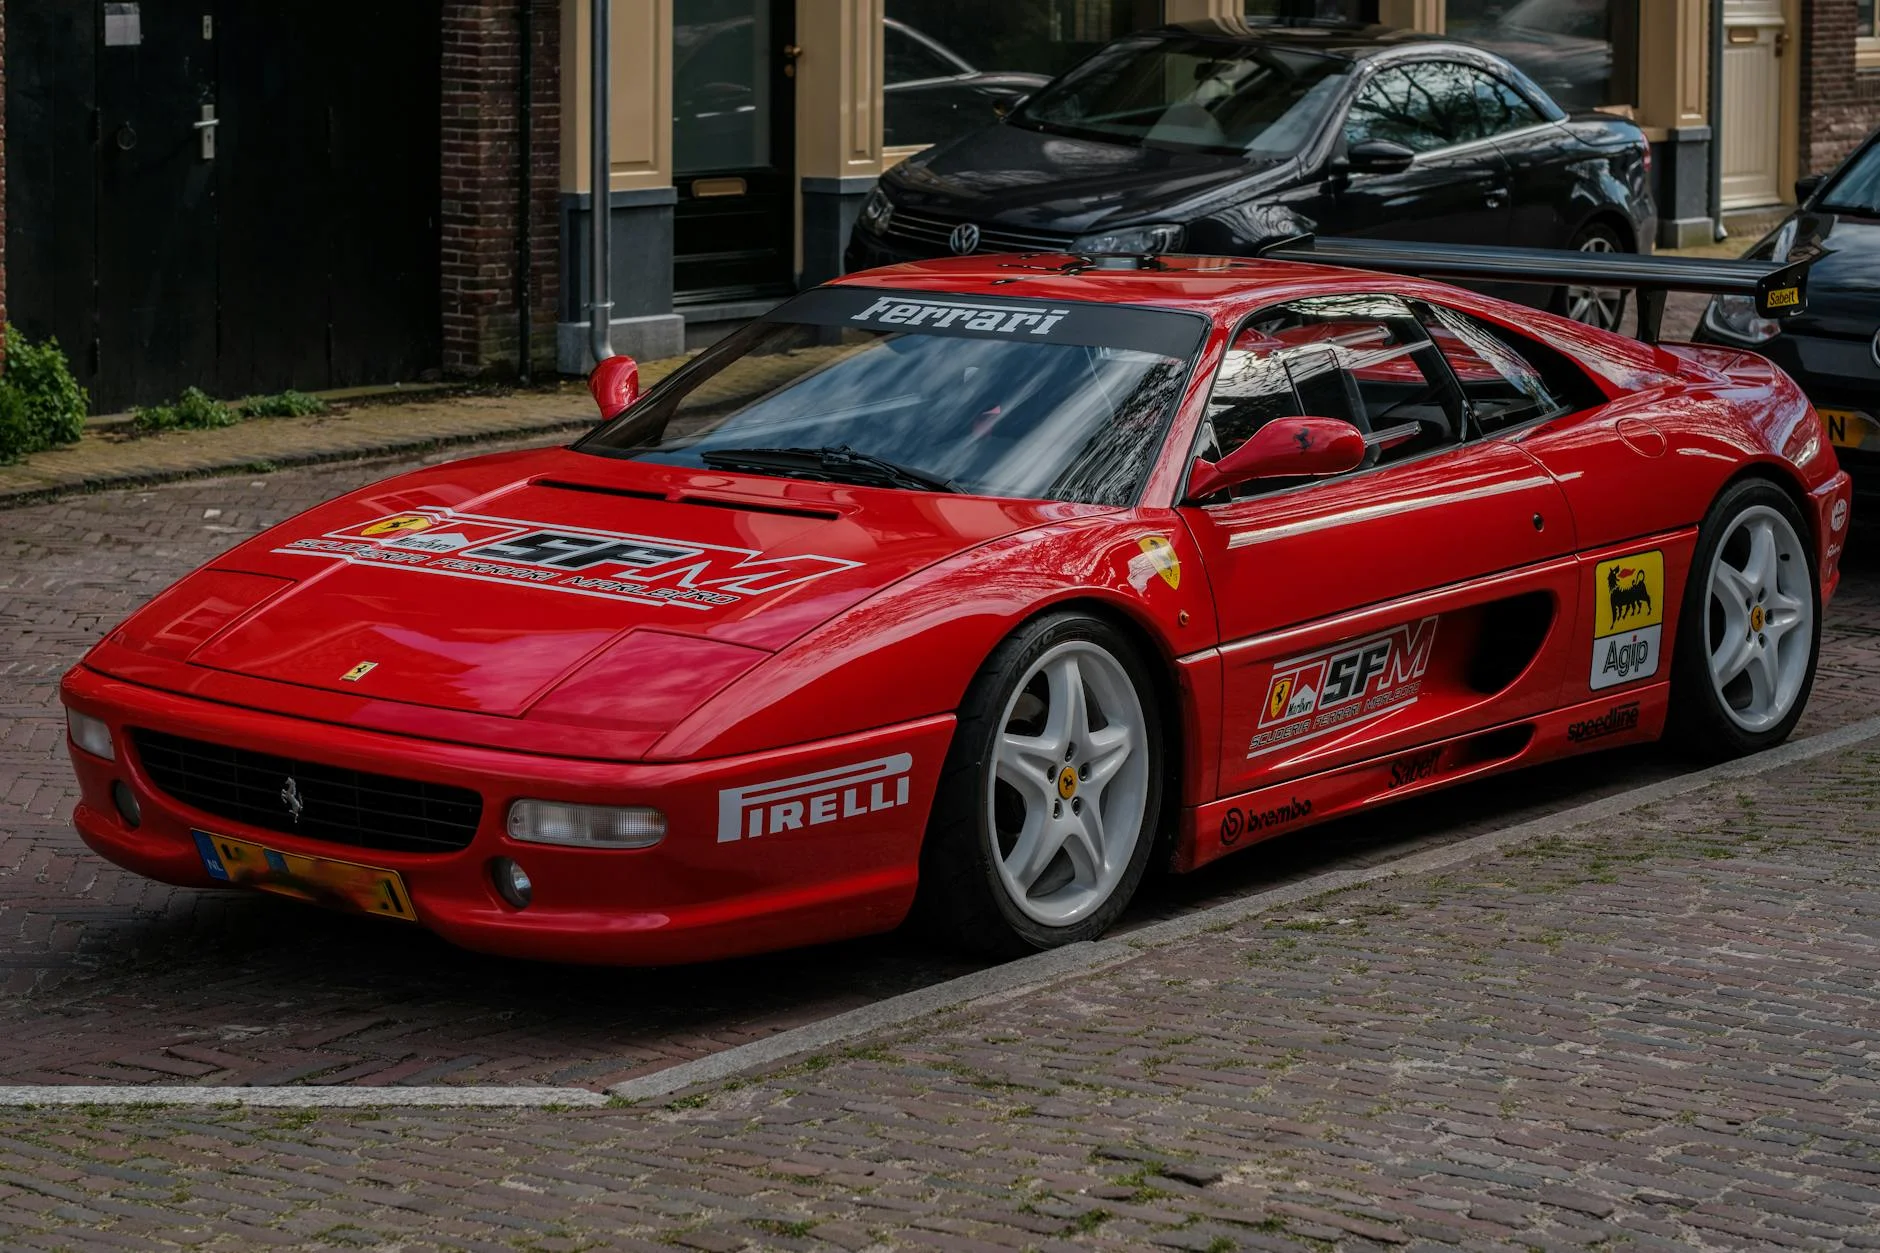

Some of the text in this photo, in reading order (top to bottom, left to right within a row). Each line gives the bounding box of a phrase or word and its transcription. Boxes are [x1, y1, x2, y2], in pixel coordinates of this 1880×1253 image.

[851, 296, 1070, 335] Ferrari
[1769, 290, 1795, 306] Sabelt
[285, 539, 432, 563] SCUDERIA
[426, 557, 562, 582] FERRARI
[458, 530, 867, 596] SFM
[1318, 615, 1439, 711] SFM
[1603, 634, 1648, 677] Agip
[1249, 719, 1311, 749] SCUDERIA
[1313, 702, 1362, 729] FERRARI
[1568, 703, 1639, 741] speedline
[717, 752, 913, 843] PIRELLI
[1248, 797, 1312, 832] brembo
[206, 859, 224, 871] NL
